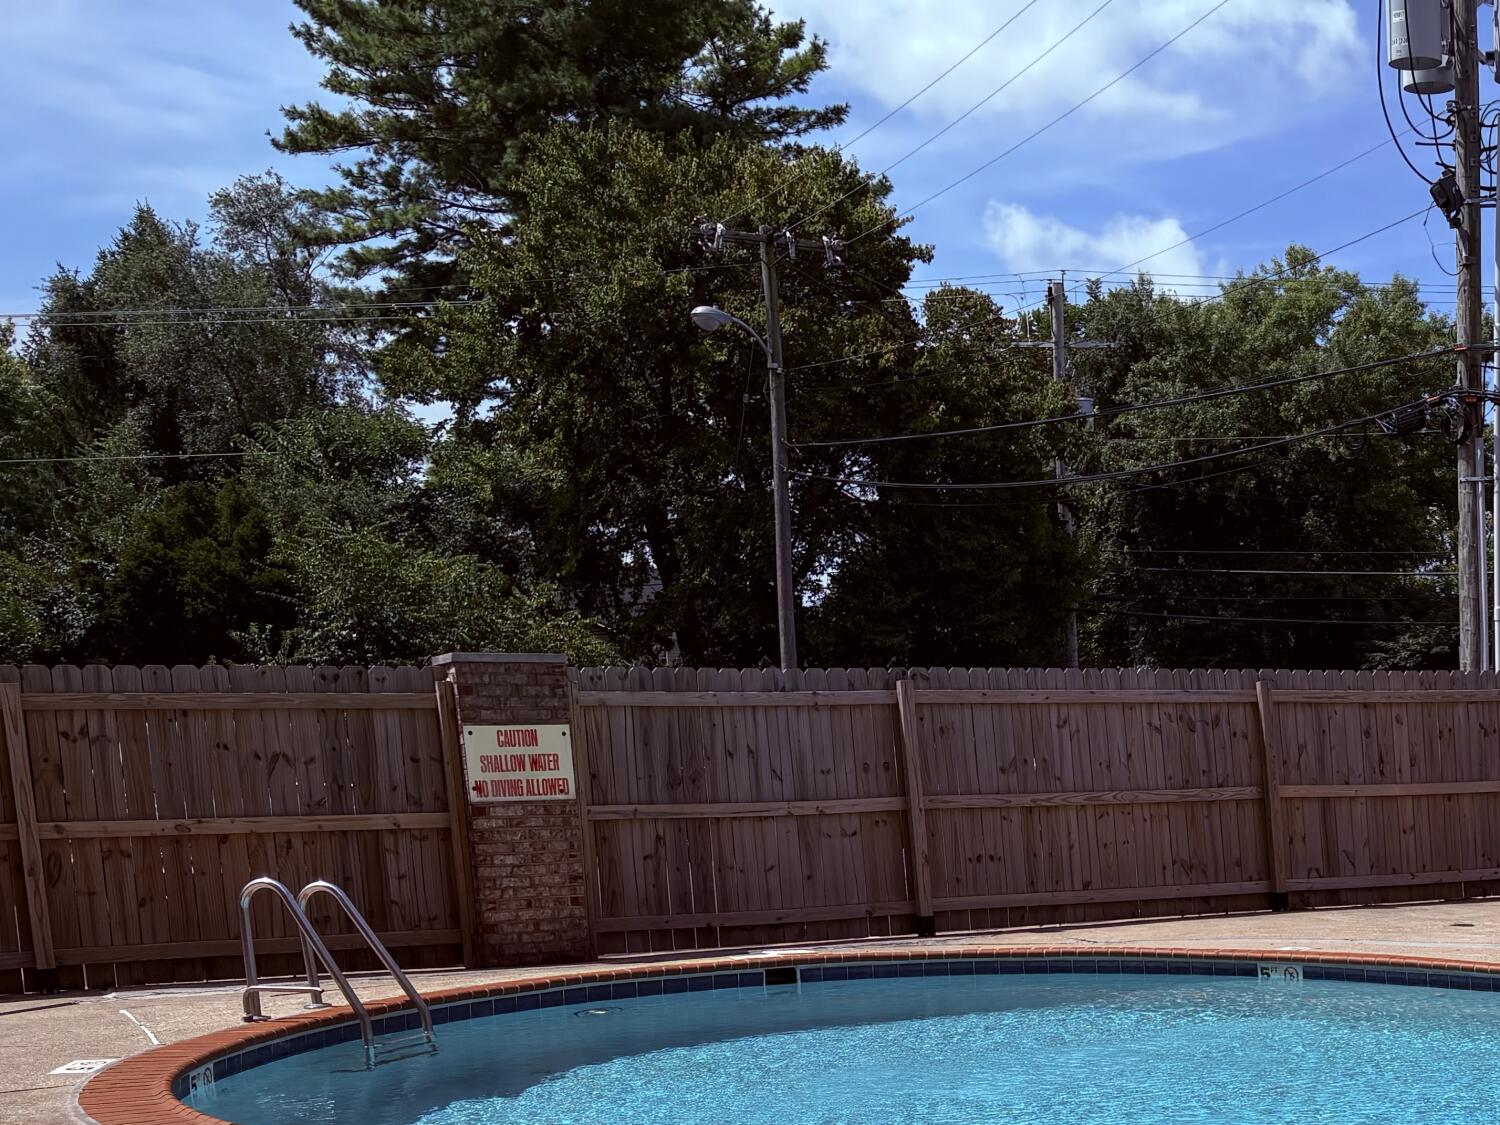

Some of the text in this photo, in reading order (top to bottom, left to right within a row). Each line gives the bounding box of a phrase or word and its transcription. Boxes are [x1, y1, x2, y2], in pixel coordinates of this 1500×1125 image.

[496, 729, 538, 748] CAUTION
[480, 753, 560, 773] SHALLOW WATER
[474, 777, 570, 798] NO DIVING ALLOWED
